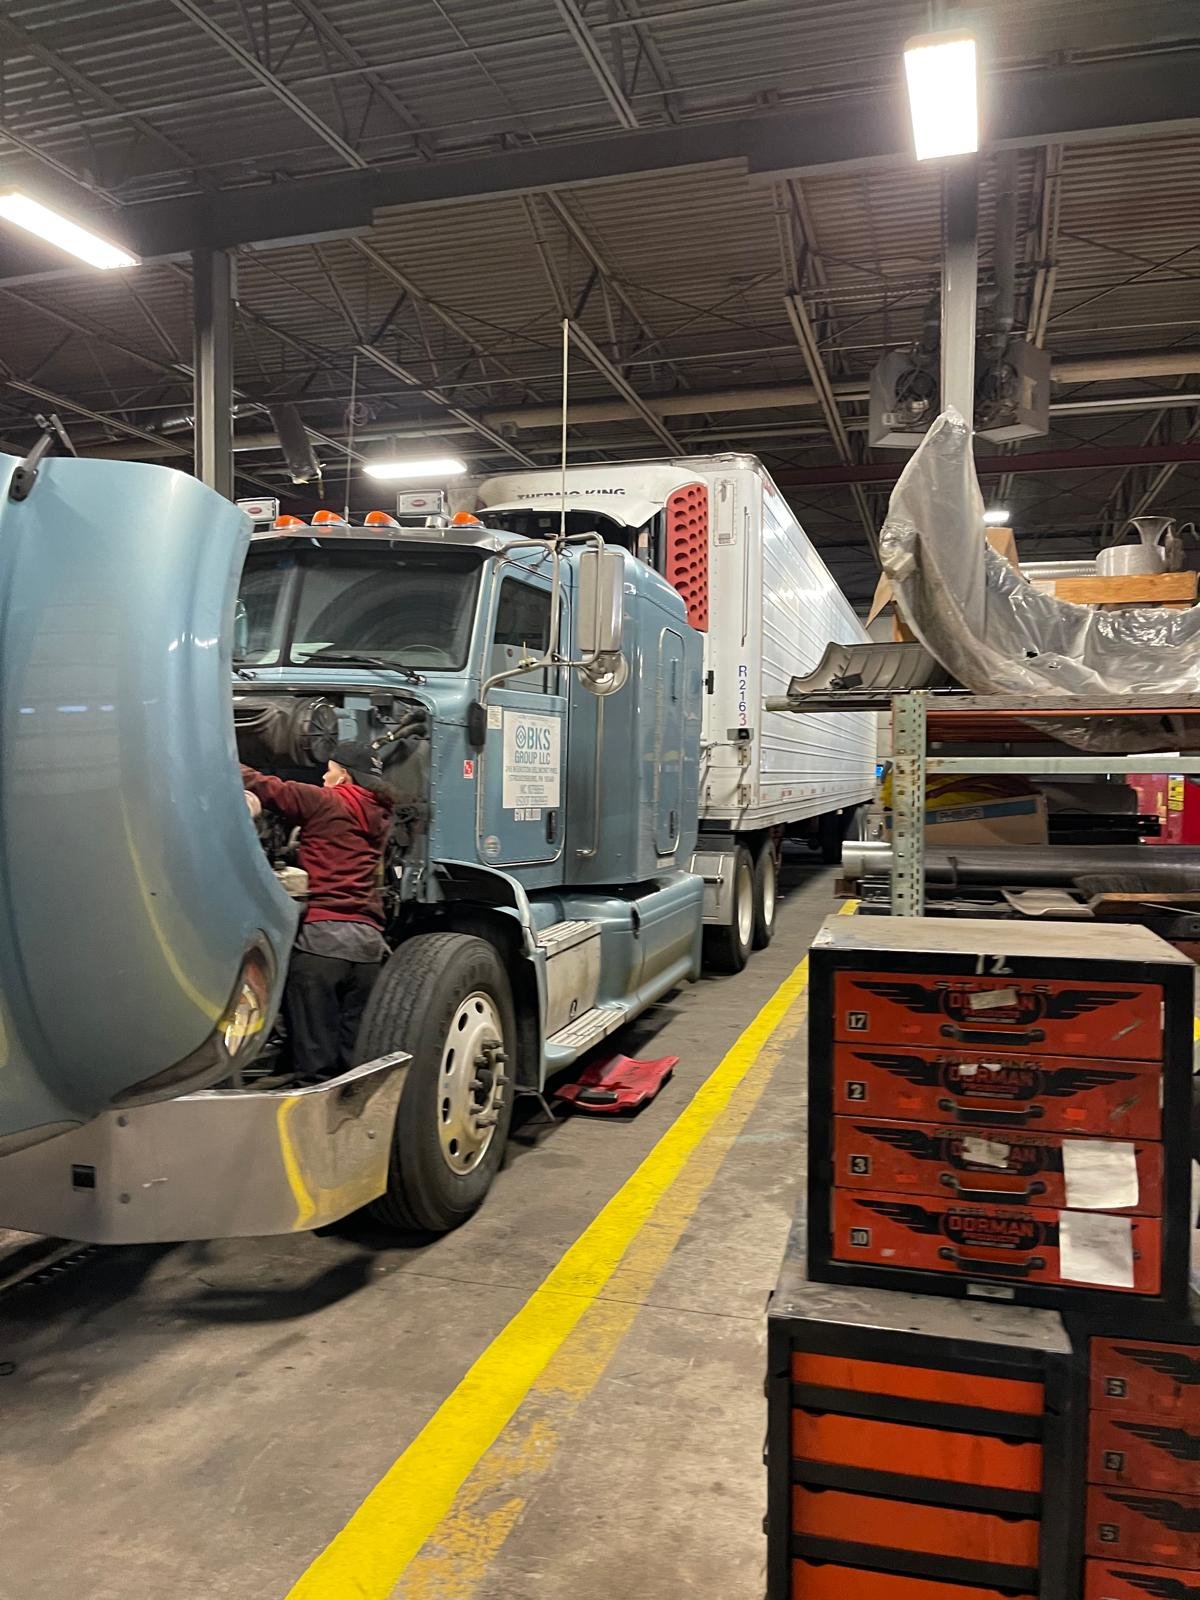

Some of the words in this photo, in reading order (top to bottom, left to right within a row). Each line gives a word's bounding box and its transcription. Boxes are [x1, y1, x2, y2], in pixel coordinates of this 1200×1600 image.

[527, 727, 551, 750] BKS
[515, 751, 537, 764] GROUP
[539, 752, 551, 765] LLC
[975, 954, 1013, 975] 12
[849, 1014, 866, 1028] 17
[850, 1084, 864, 1099] 2
[853, 1157, 867, 1172] 3
[948, 1215, 1034, 1237] DORMAN
[851, 1230, 867, 1245] 10
